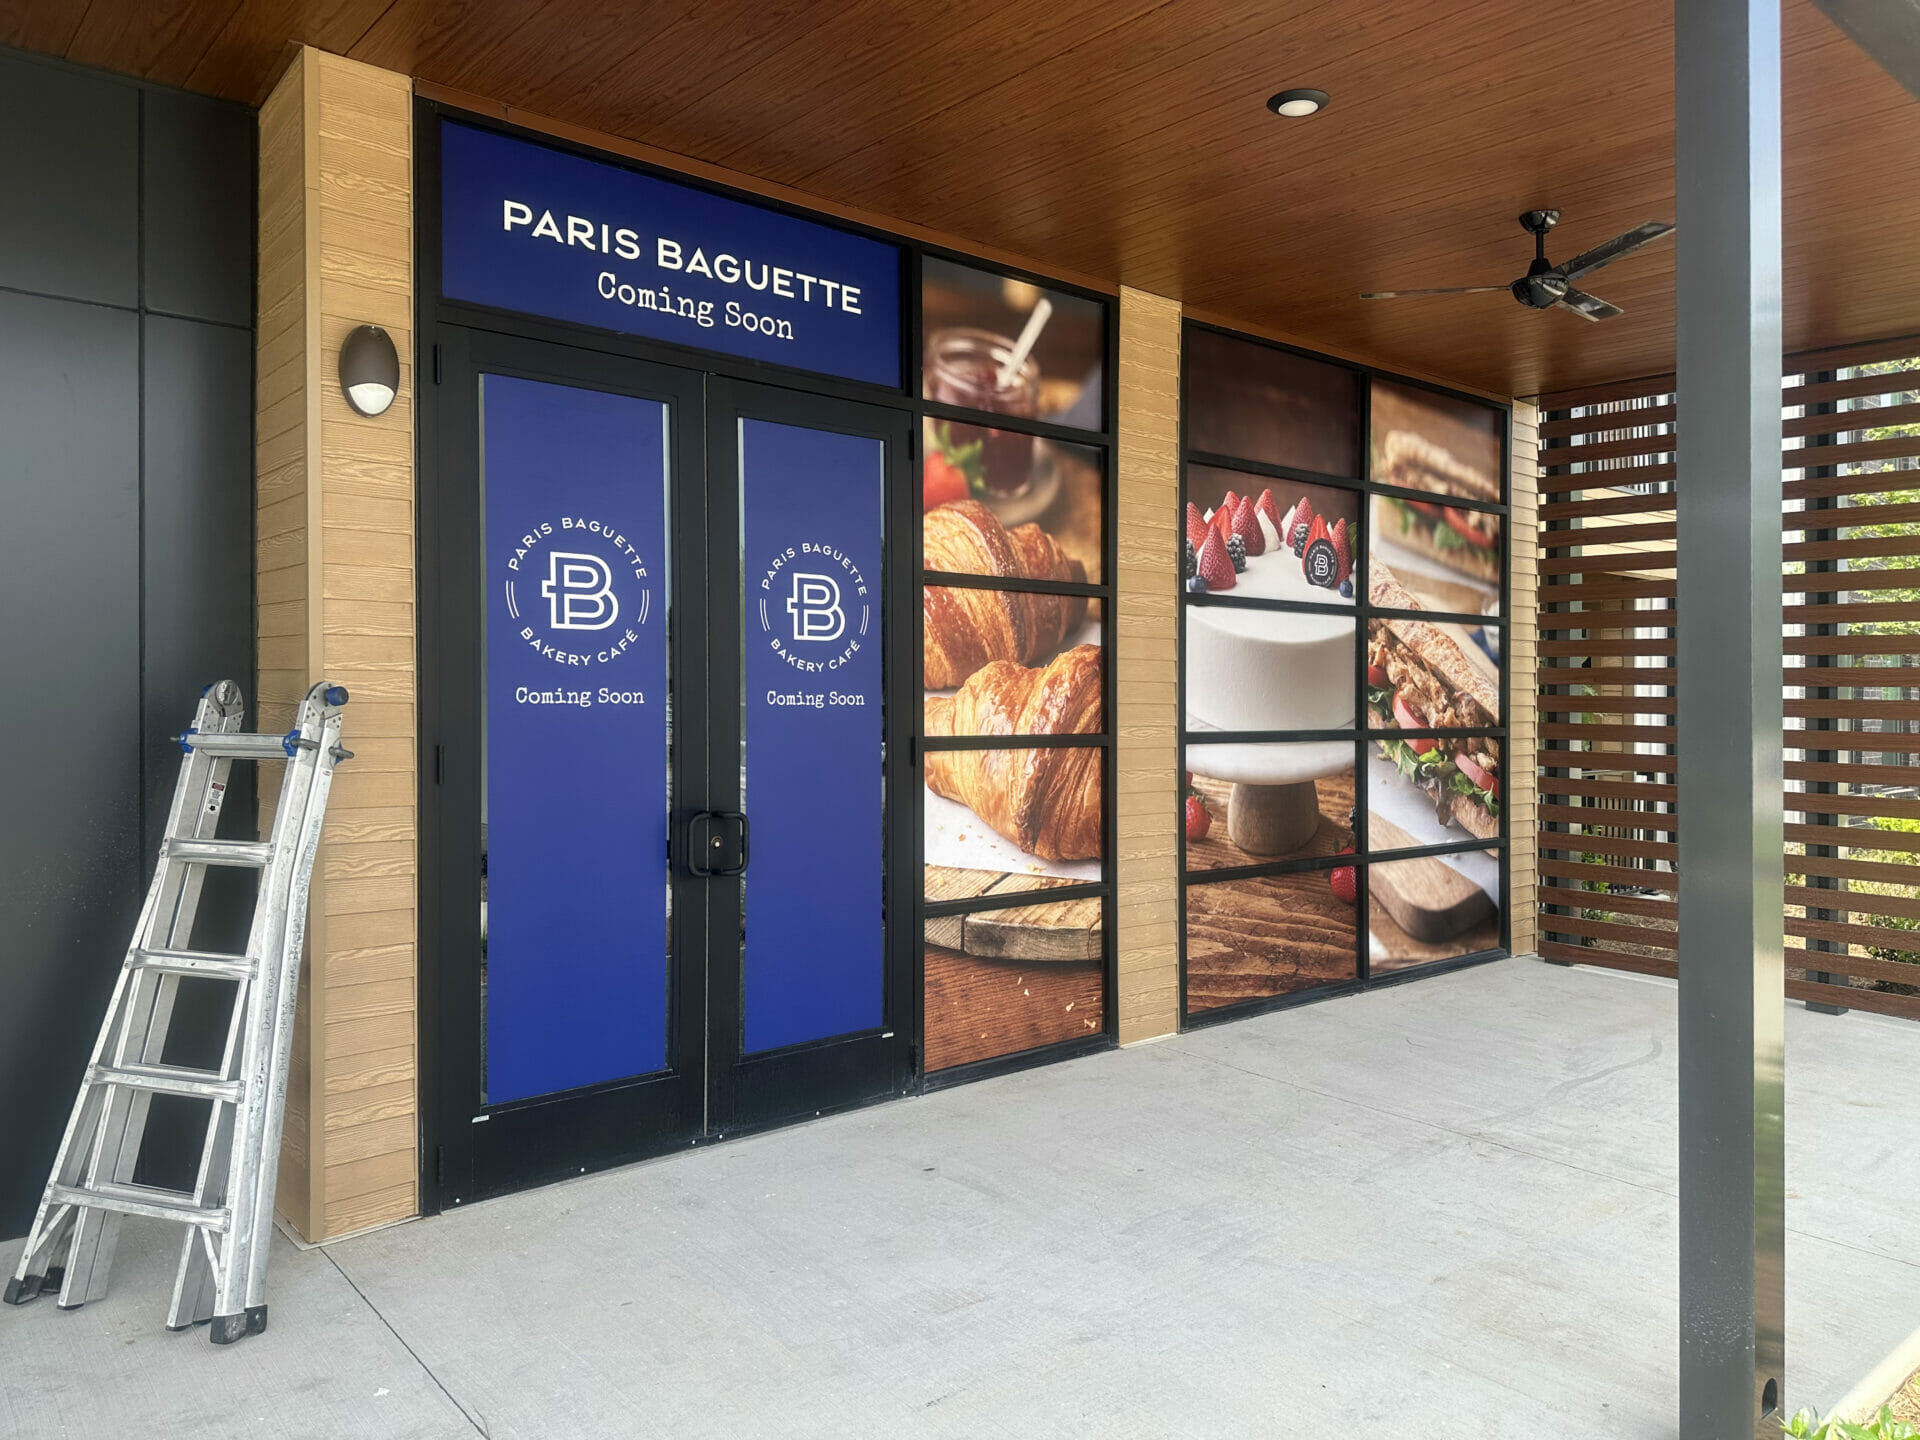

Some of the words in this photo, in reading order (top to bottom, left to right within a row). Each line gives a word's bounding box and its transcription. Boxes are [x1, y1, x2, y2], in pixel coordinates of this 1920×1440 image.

[504, 200, 640, 259] PARIS
[658, 238, 861, 314] BAGUETTE
[599, 272, 713, 327] Coming
[726, 302, 793, 339] Soon
[509, 523, 552, 570] PARIS
[562, 518, 646, 579] BAGUETTE
[762, 548, 795, 589] PARIS
[803, 543, 867, 595] BAGUETTE
[521, 627, 591, 665] BAKERY
[771, 639, 824, 672] BAKERY
[516, 687, 591, 707] Coming
[599, 688, 644, 703] Soon
[767, 691, 824, 708] Coming
[830, 692, 864, 705] Soon
